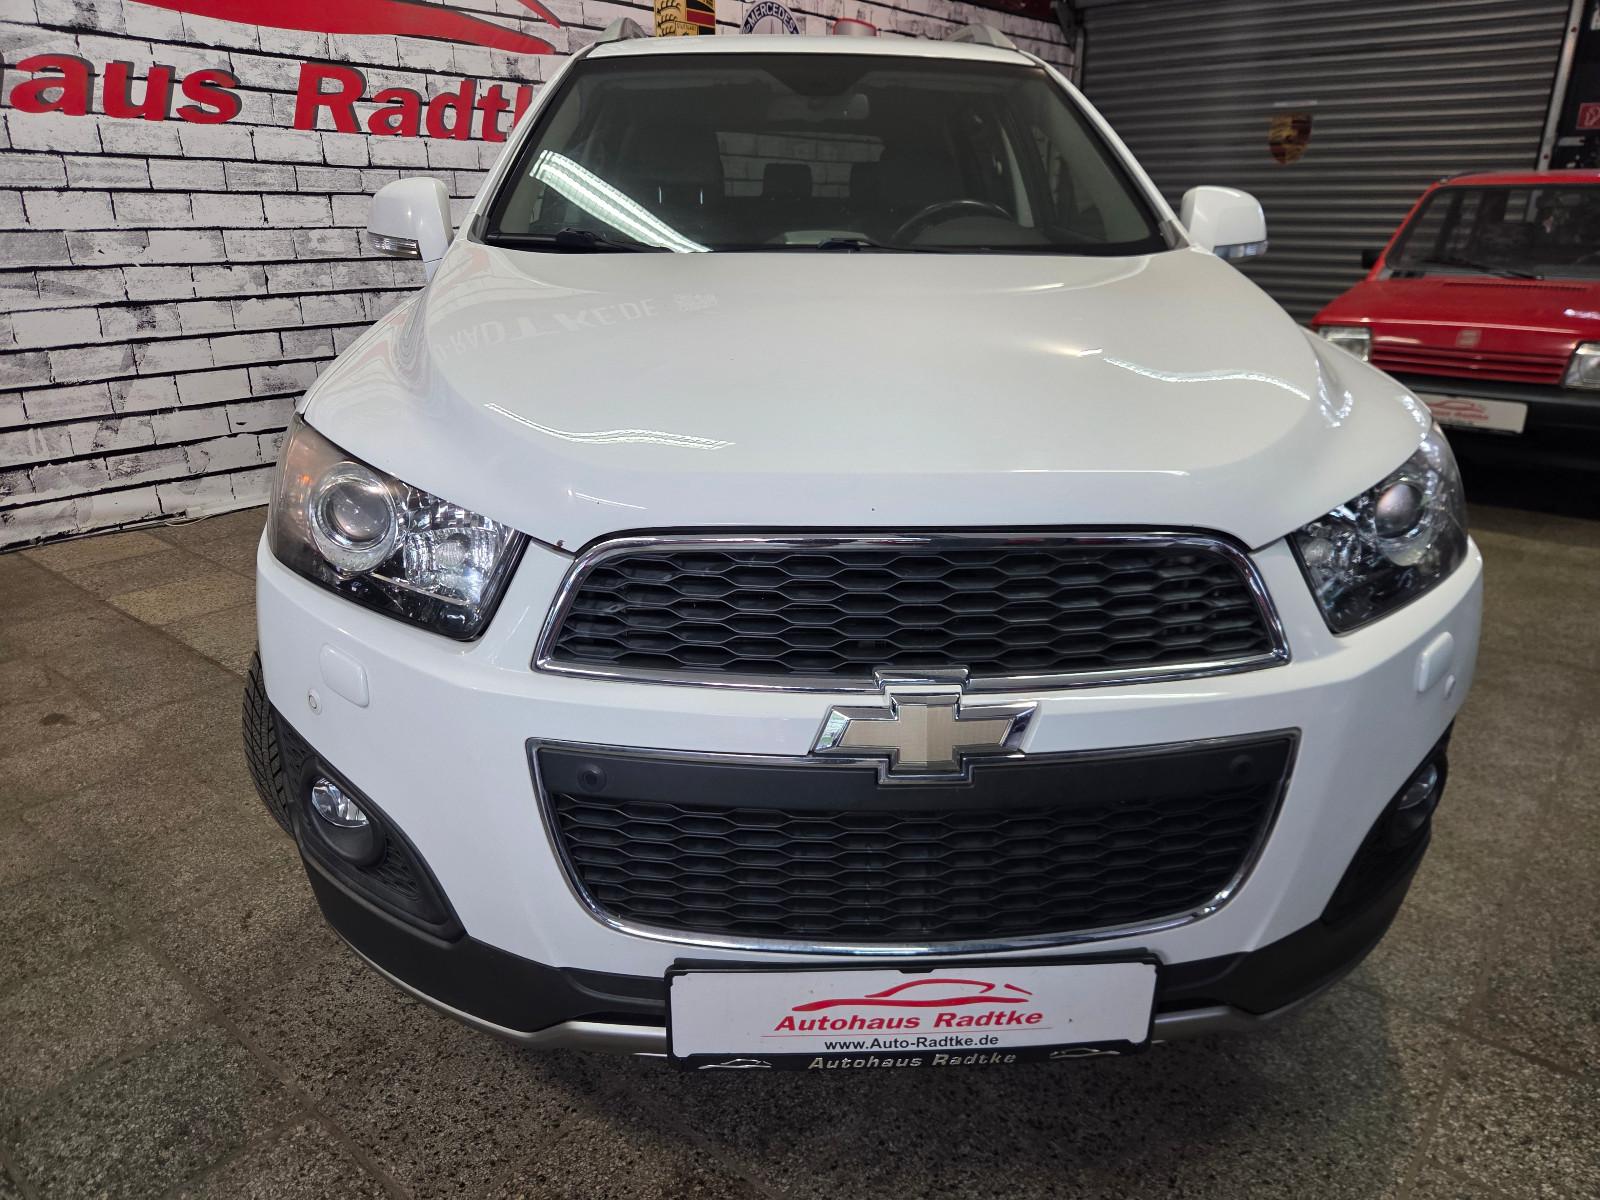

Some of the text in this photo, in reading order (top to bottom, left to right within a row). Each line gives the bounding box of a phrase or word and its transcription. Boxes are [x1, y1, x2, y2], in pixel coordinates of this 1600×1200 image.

[747, 2, 796, 32] MERCEDES
[2, 54, 243, 124] aus
[774, 1010, 1044, 1032] Autohaus Radtke
[824, 1035, 1000, 1051] www.Auto-Radtke.de
[808, 1052, 1017, 1070] Autohaus Radtke
